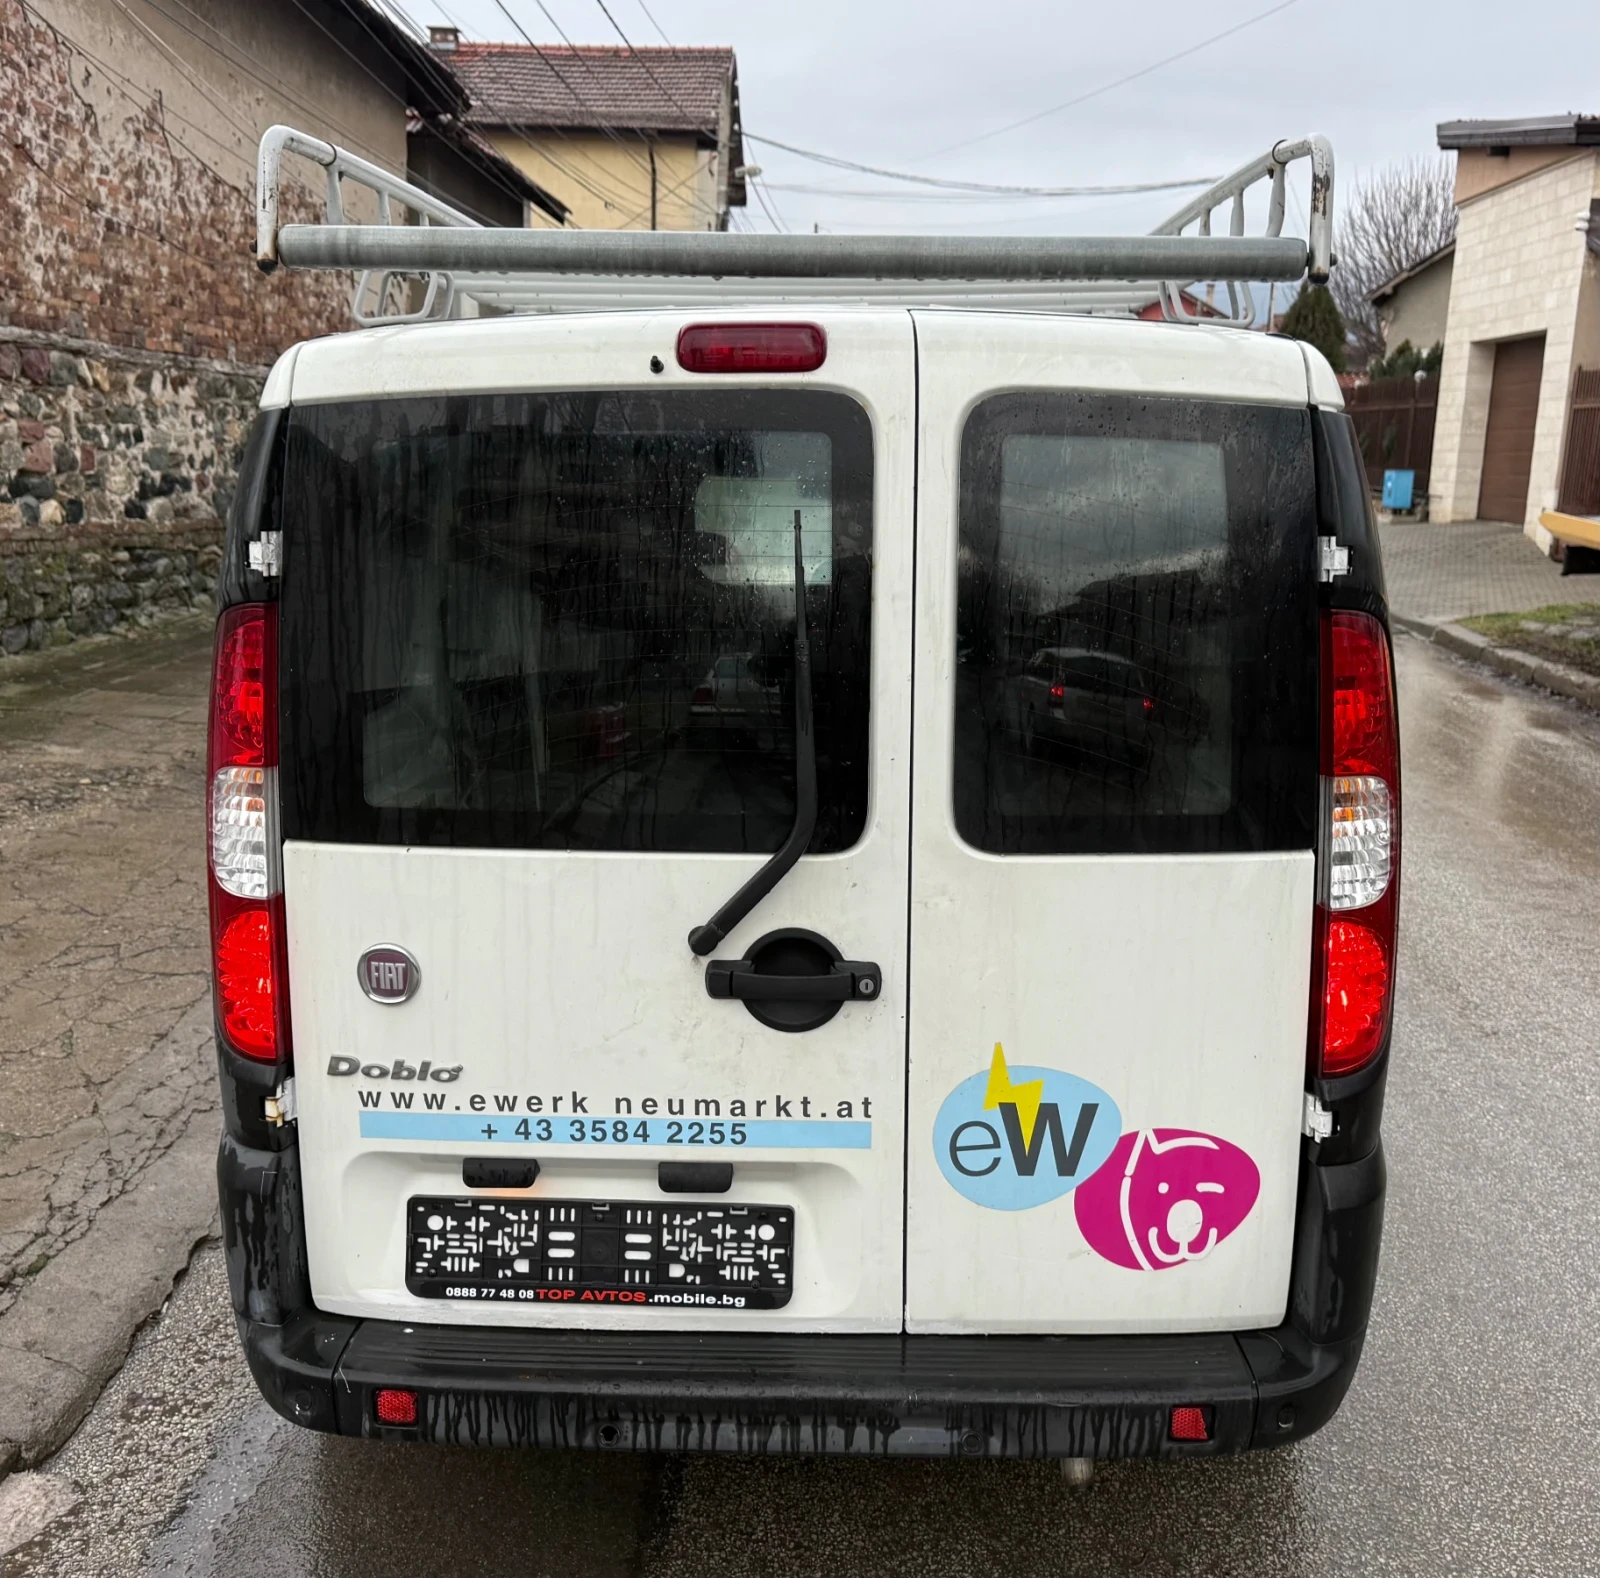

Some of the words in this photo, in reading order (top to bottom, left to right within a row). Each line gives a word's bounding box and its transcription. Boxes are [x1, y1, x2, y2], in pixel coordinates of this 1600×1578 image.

[371, 961, 406, 990] FIAT
[358, 1090, 589, 1114] www.ewerk
[614, 1094, 873, 1119] neumarkt.at
[480, 1122, 499, 1140] +
[514, 1118, 554, 1142] 43
[568, 1119, 650, 1144] 3584
[666, 1121, 748, 1146] 2255
[445, 1286, 477, 1298] 0888
[480, 1287, 496, 1298] 77
[499, 1288, 515, 1299] 48
[518, 1288, 534, 1299] 08
[536, 1288, 576, 1300] TOP
[580, 1290, 646, 1302] AVTOS
[648, 1292, 746, 1308] .mobile.bg
